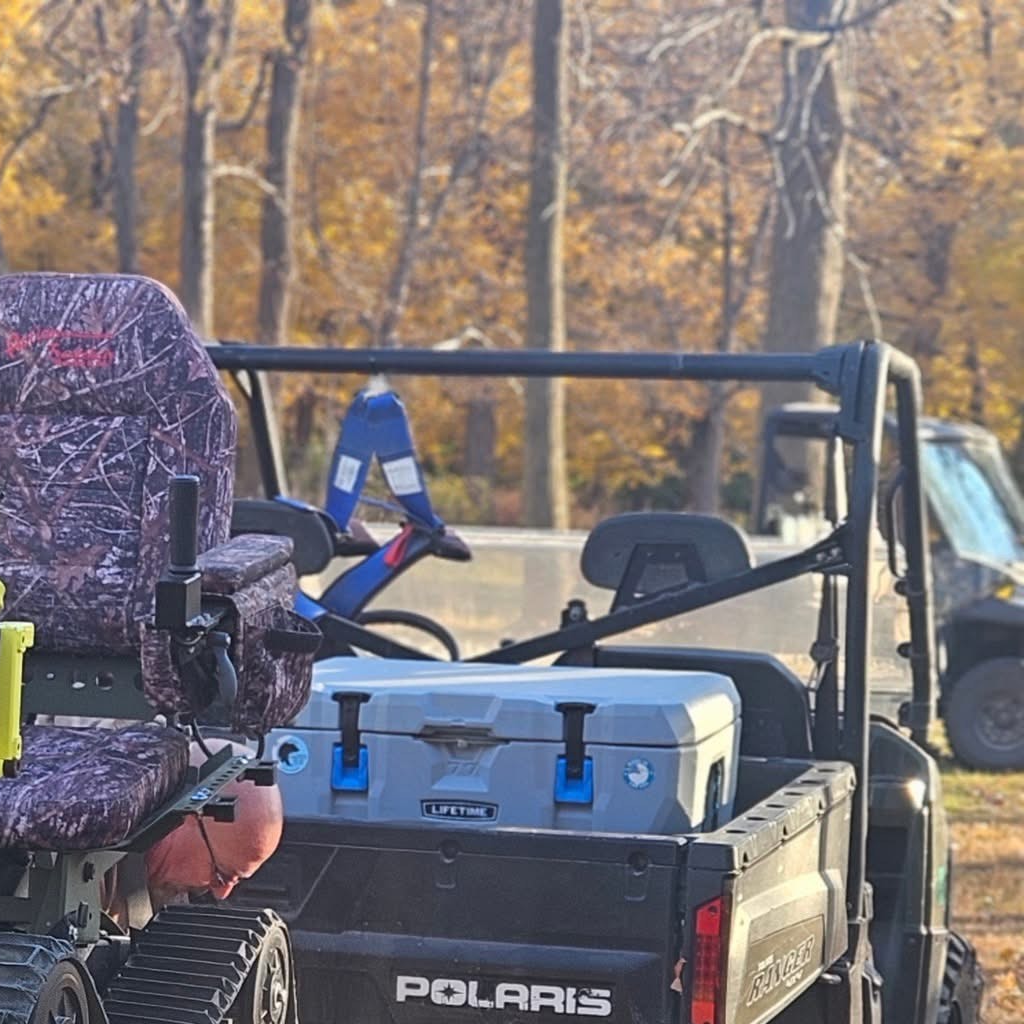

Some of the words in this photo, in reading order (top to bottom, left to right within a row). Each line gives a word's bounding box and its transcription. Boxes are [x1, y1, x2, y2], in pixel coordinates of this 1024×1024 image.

[431, 804, 488, 817] LIFETIME
[746, 934, 815, 1007] RANGER
[396, 975, 612, 1018] POLARIS
